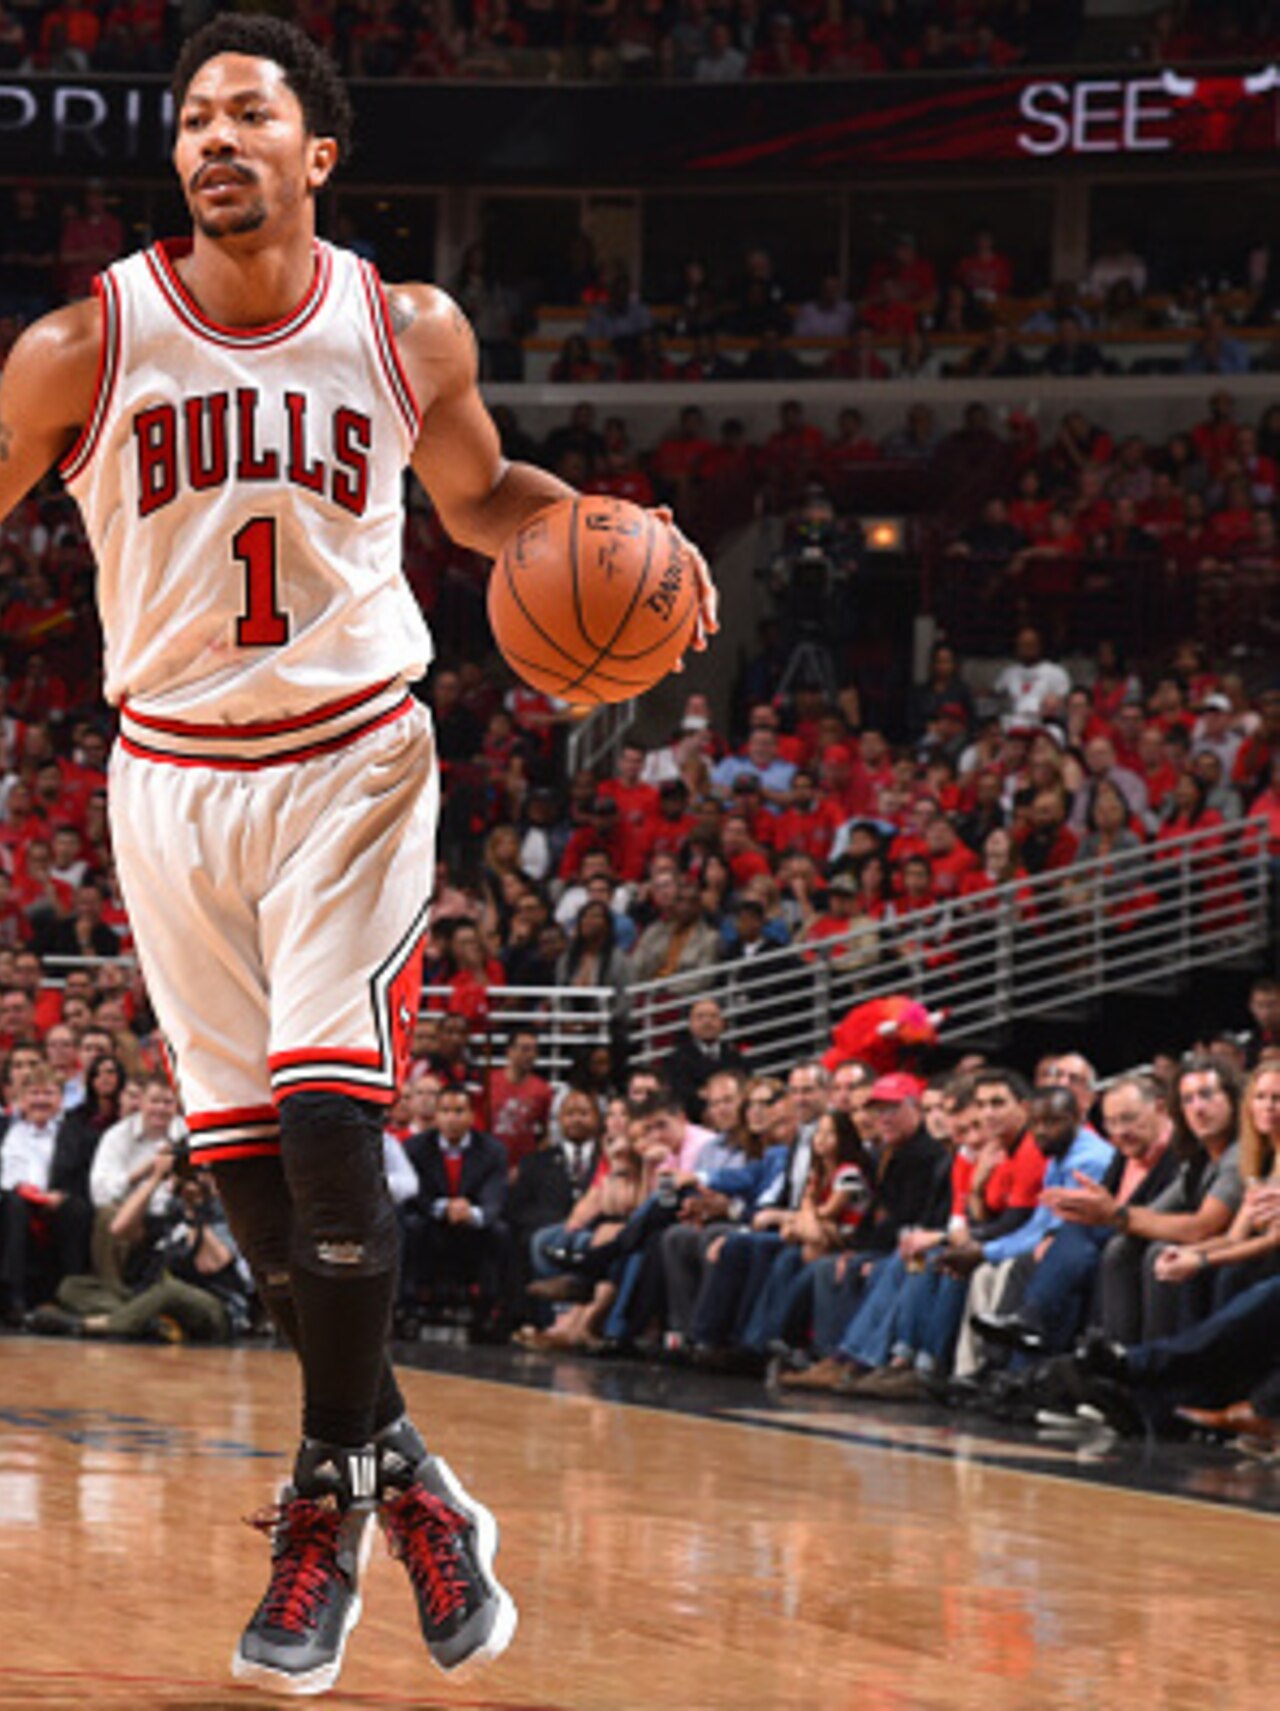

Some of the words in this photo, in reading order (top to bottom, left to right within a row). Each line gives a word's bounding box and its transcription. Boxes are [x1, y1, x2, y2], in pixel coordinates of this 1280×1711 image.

[1018, 79, 1174, 155] SEE
[133, 387, 372, 518] BULLS
[231, 516, 290, 647] 1
